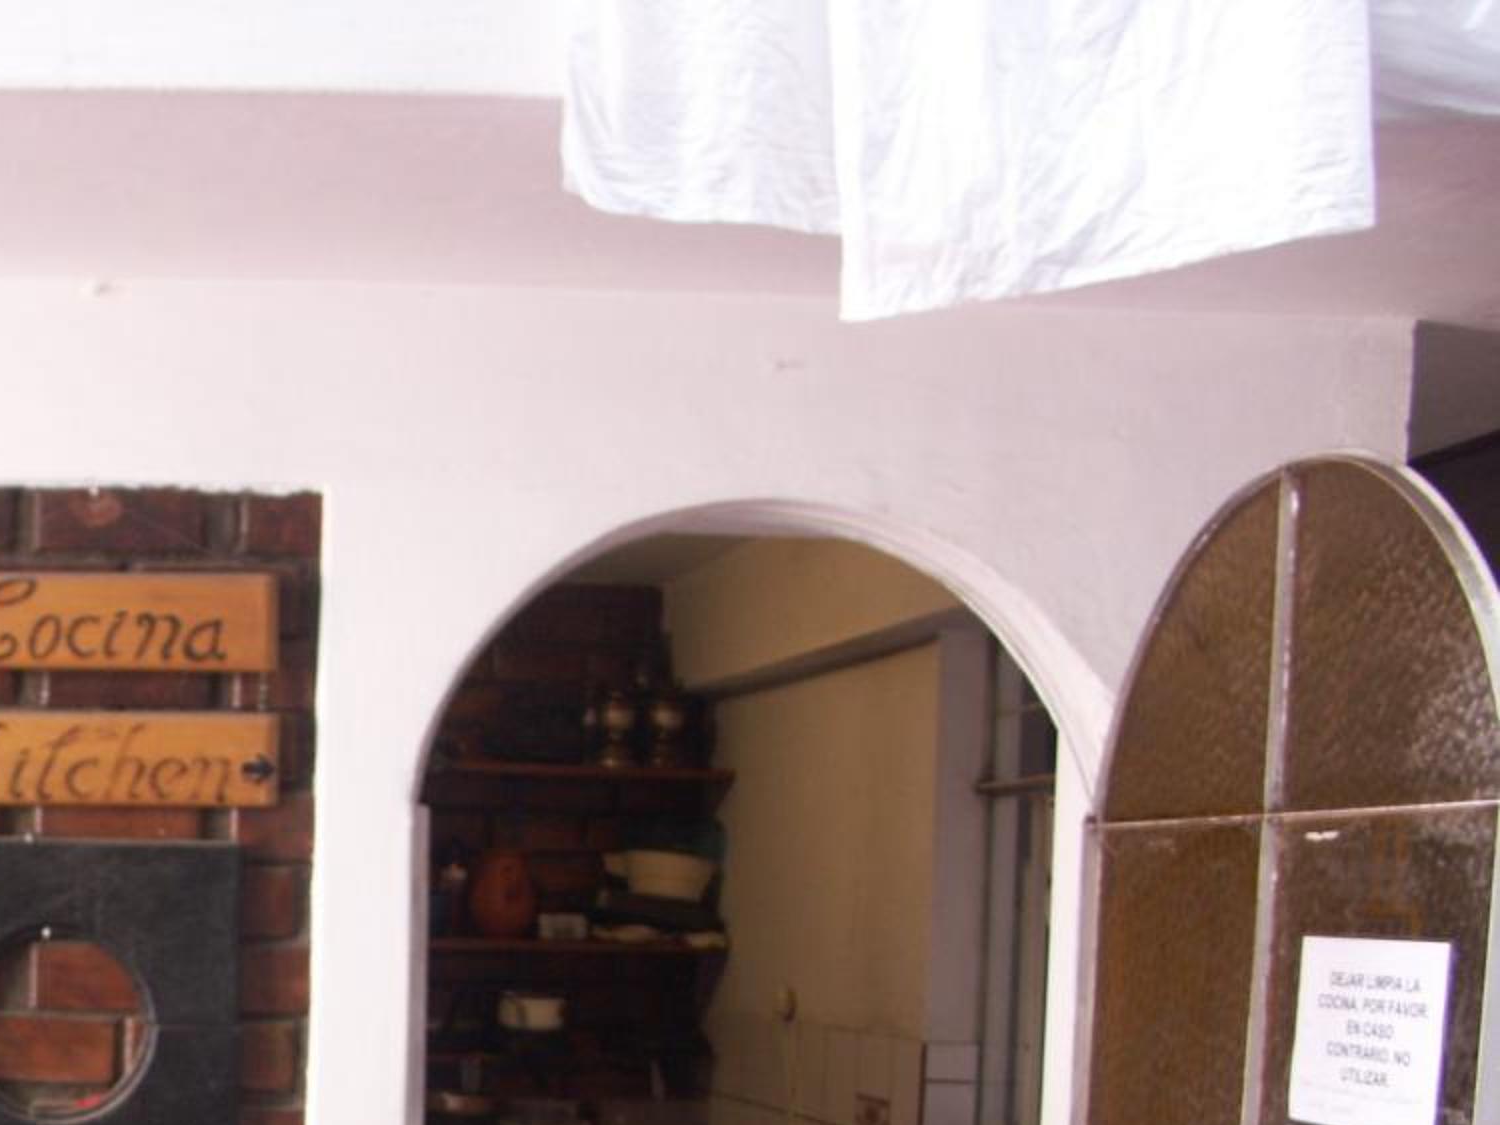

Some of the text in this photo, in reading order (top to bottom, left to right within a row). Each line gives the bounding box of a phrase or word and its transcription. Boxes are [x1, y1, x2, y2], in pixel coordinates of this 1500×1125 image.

[1330, 971, 1421, 993] DEJAR LIMPIA LA
[1362, 997, 1387, 1015] POR
[1347, 1018, 1395, 1041] EN CASO
[1393, 1050, 1411, 1068] NO
